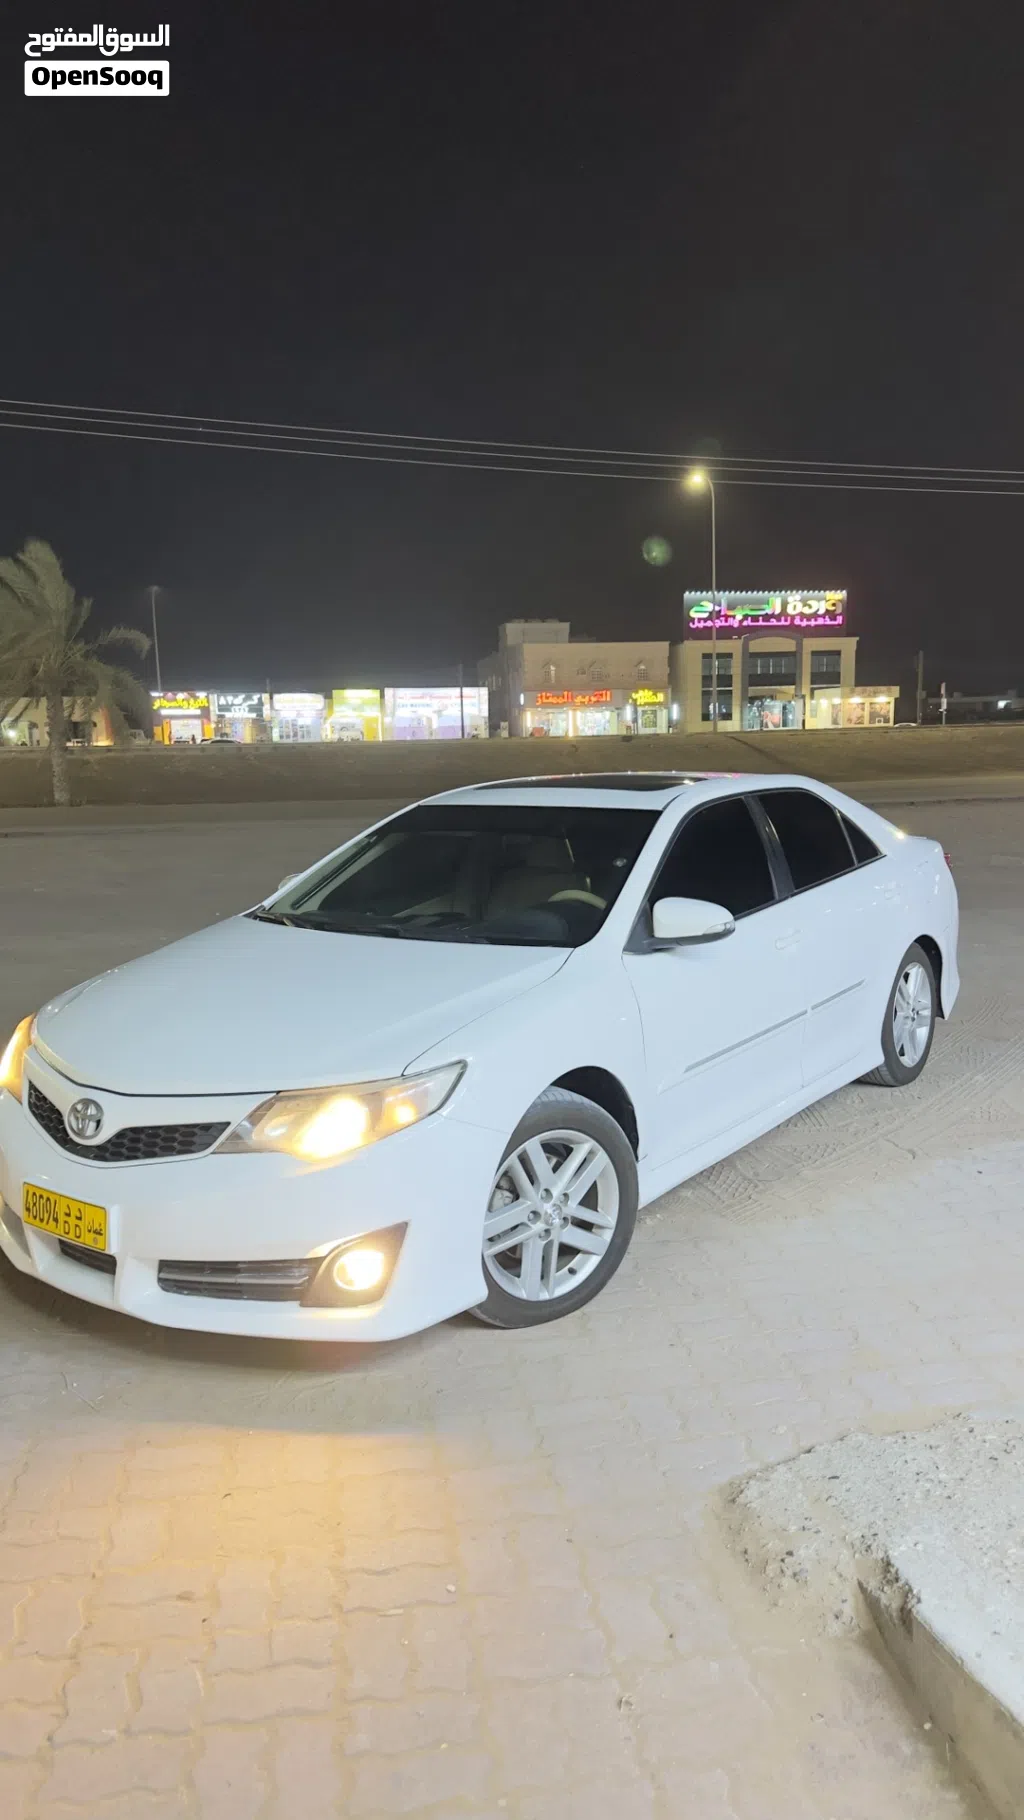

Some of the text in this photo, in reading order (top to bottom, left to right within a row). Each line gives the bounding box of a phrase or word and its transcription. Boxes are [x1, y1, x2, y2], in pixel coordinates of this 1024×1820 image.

[742, 616, 791, 627] للحناء
[794, 616, 843, 627] الذهبية
[536, 690, 572, 706] الممتاز
[24, 1188, 60, 1229] 48094
